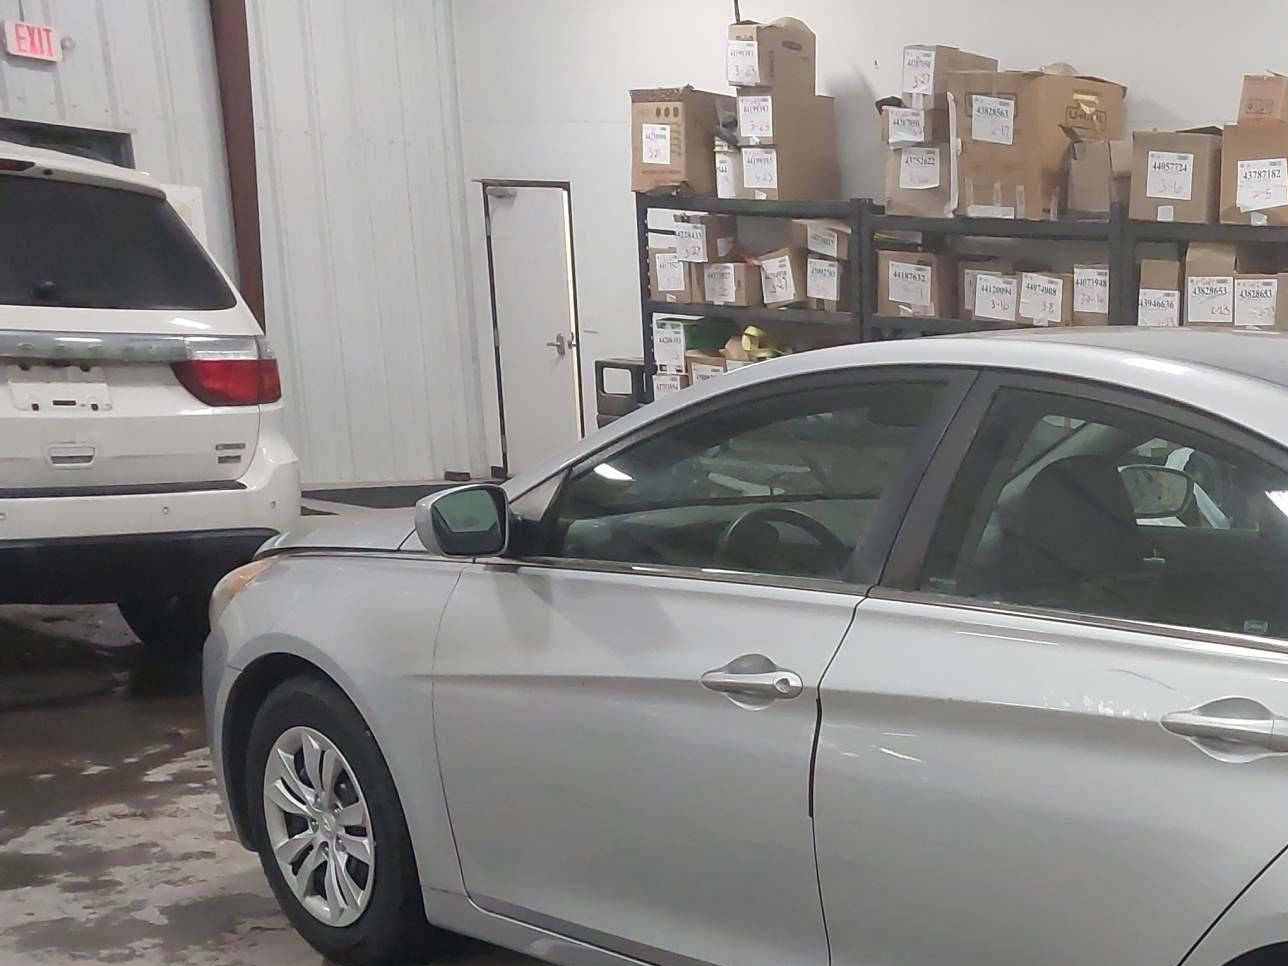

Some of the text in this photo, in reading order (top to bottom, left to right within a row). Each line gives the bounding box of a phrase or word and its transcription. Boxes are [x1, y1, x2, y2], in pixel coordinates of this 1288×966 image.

[15, 23, 53, 57] EXIT
[1152, 161, 1187, 172] 44057724
[1243, 169, 1281, 180] 43787182
[1192, 286, 1228, 296] 43828653
